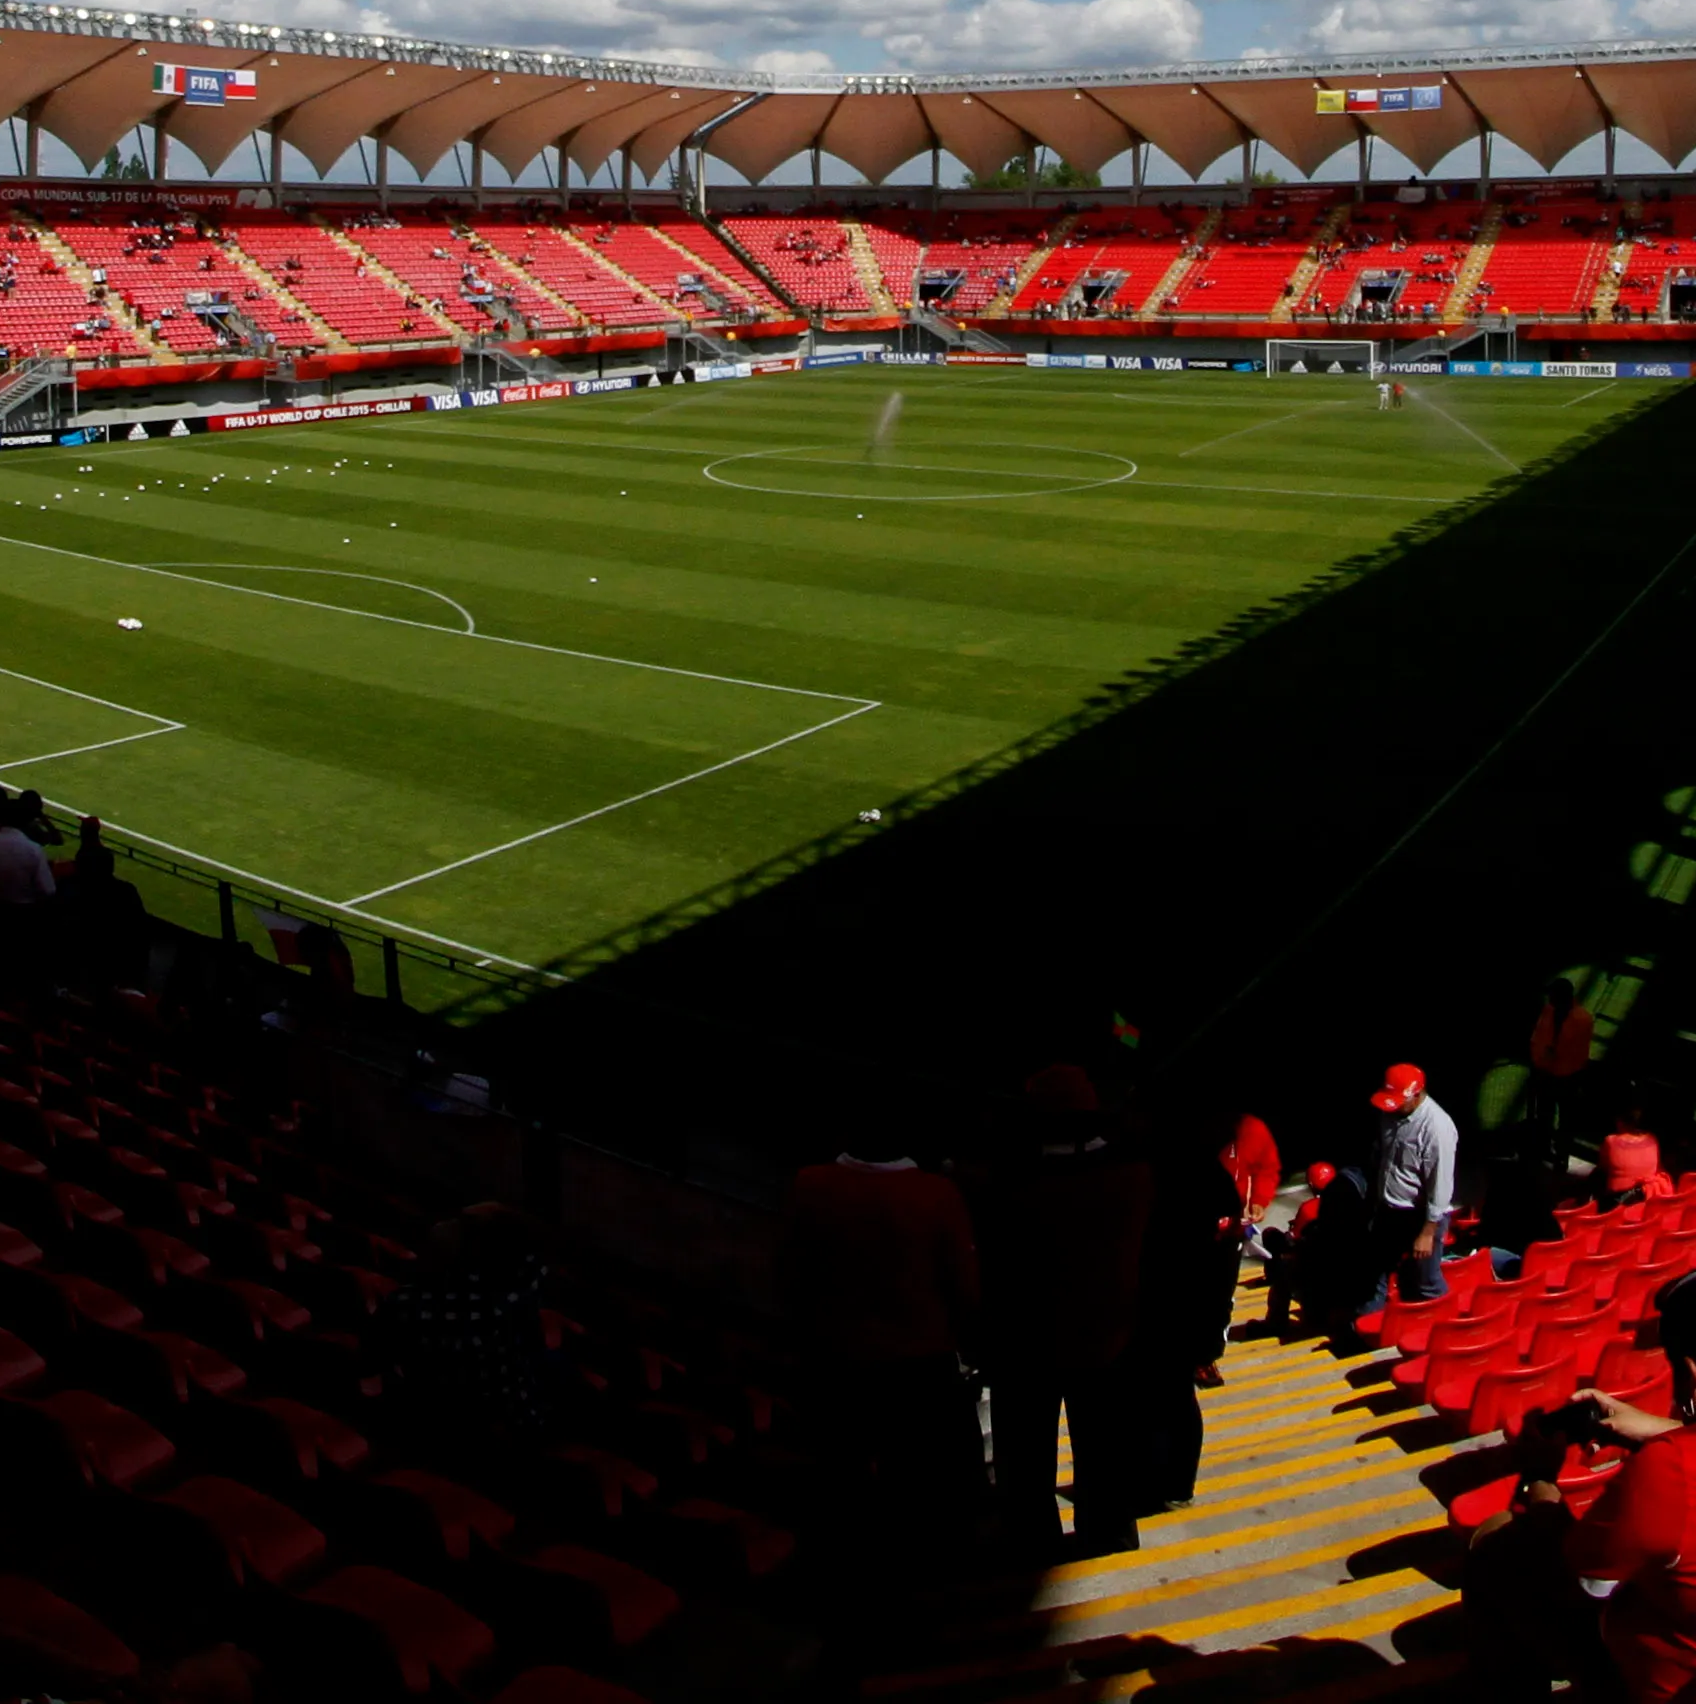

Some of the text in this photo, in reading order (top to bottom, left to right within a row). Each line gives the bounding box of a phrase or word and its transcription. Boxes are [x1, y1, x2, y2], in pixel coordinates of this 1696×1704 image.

[191, 75, 219, 91] FIFA
[1384, 93, 1405, 103] FIFA
[0, 188, 31, 200] COPA
[34, 189, 83, 202] MUNDIAL
[87, 190, 122, 202] SUB-17
[125, 191, 139, 203] DE
[178, 194, 204, 205] CHILE
[1111, 356, 1142, 369] VISA
[1151, 357, 1183, 370] VISA
[1389, 362, 1442, 373] HYUNDAI
[1454, 364, 1475, 373] FIFA
[1546, 365, 1577, 376] SANTO
[1579, 365, 1613, 376] TOMAS
[539, 383, 563, 397] Coca-Cola
[592, 377, 632, 391] HYUNDAI
[432, 393, 462, 410] VISA
[469, 389, 500, 406] VISA
[504, 387, 528, 403] Coca-Cola
[225, 417, 246, 429] FIFA
[247, 414, 268, 426] U-17
[269, 411, 302, 424] WORLD
[304, 409, 322, 421] CUP
[323, 406, 348, 419] CHILE
[349, 404, 370, 417] 2015
[0, 434, 53, 446] POWERADE
